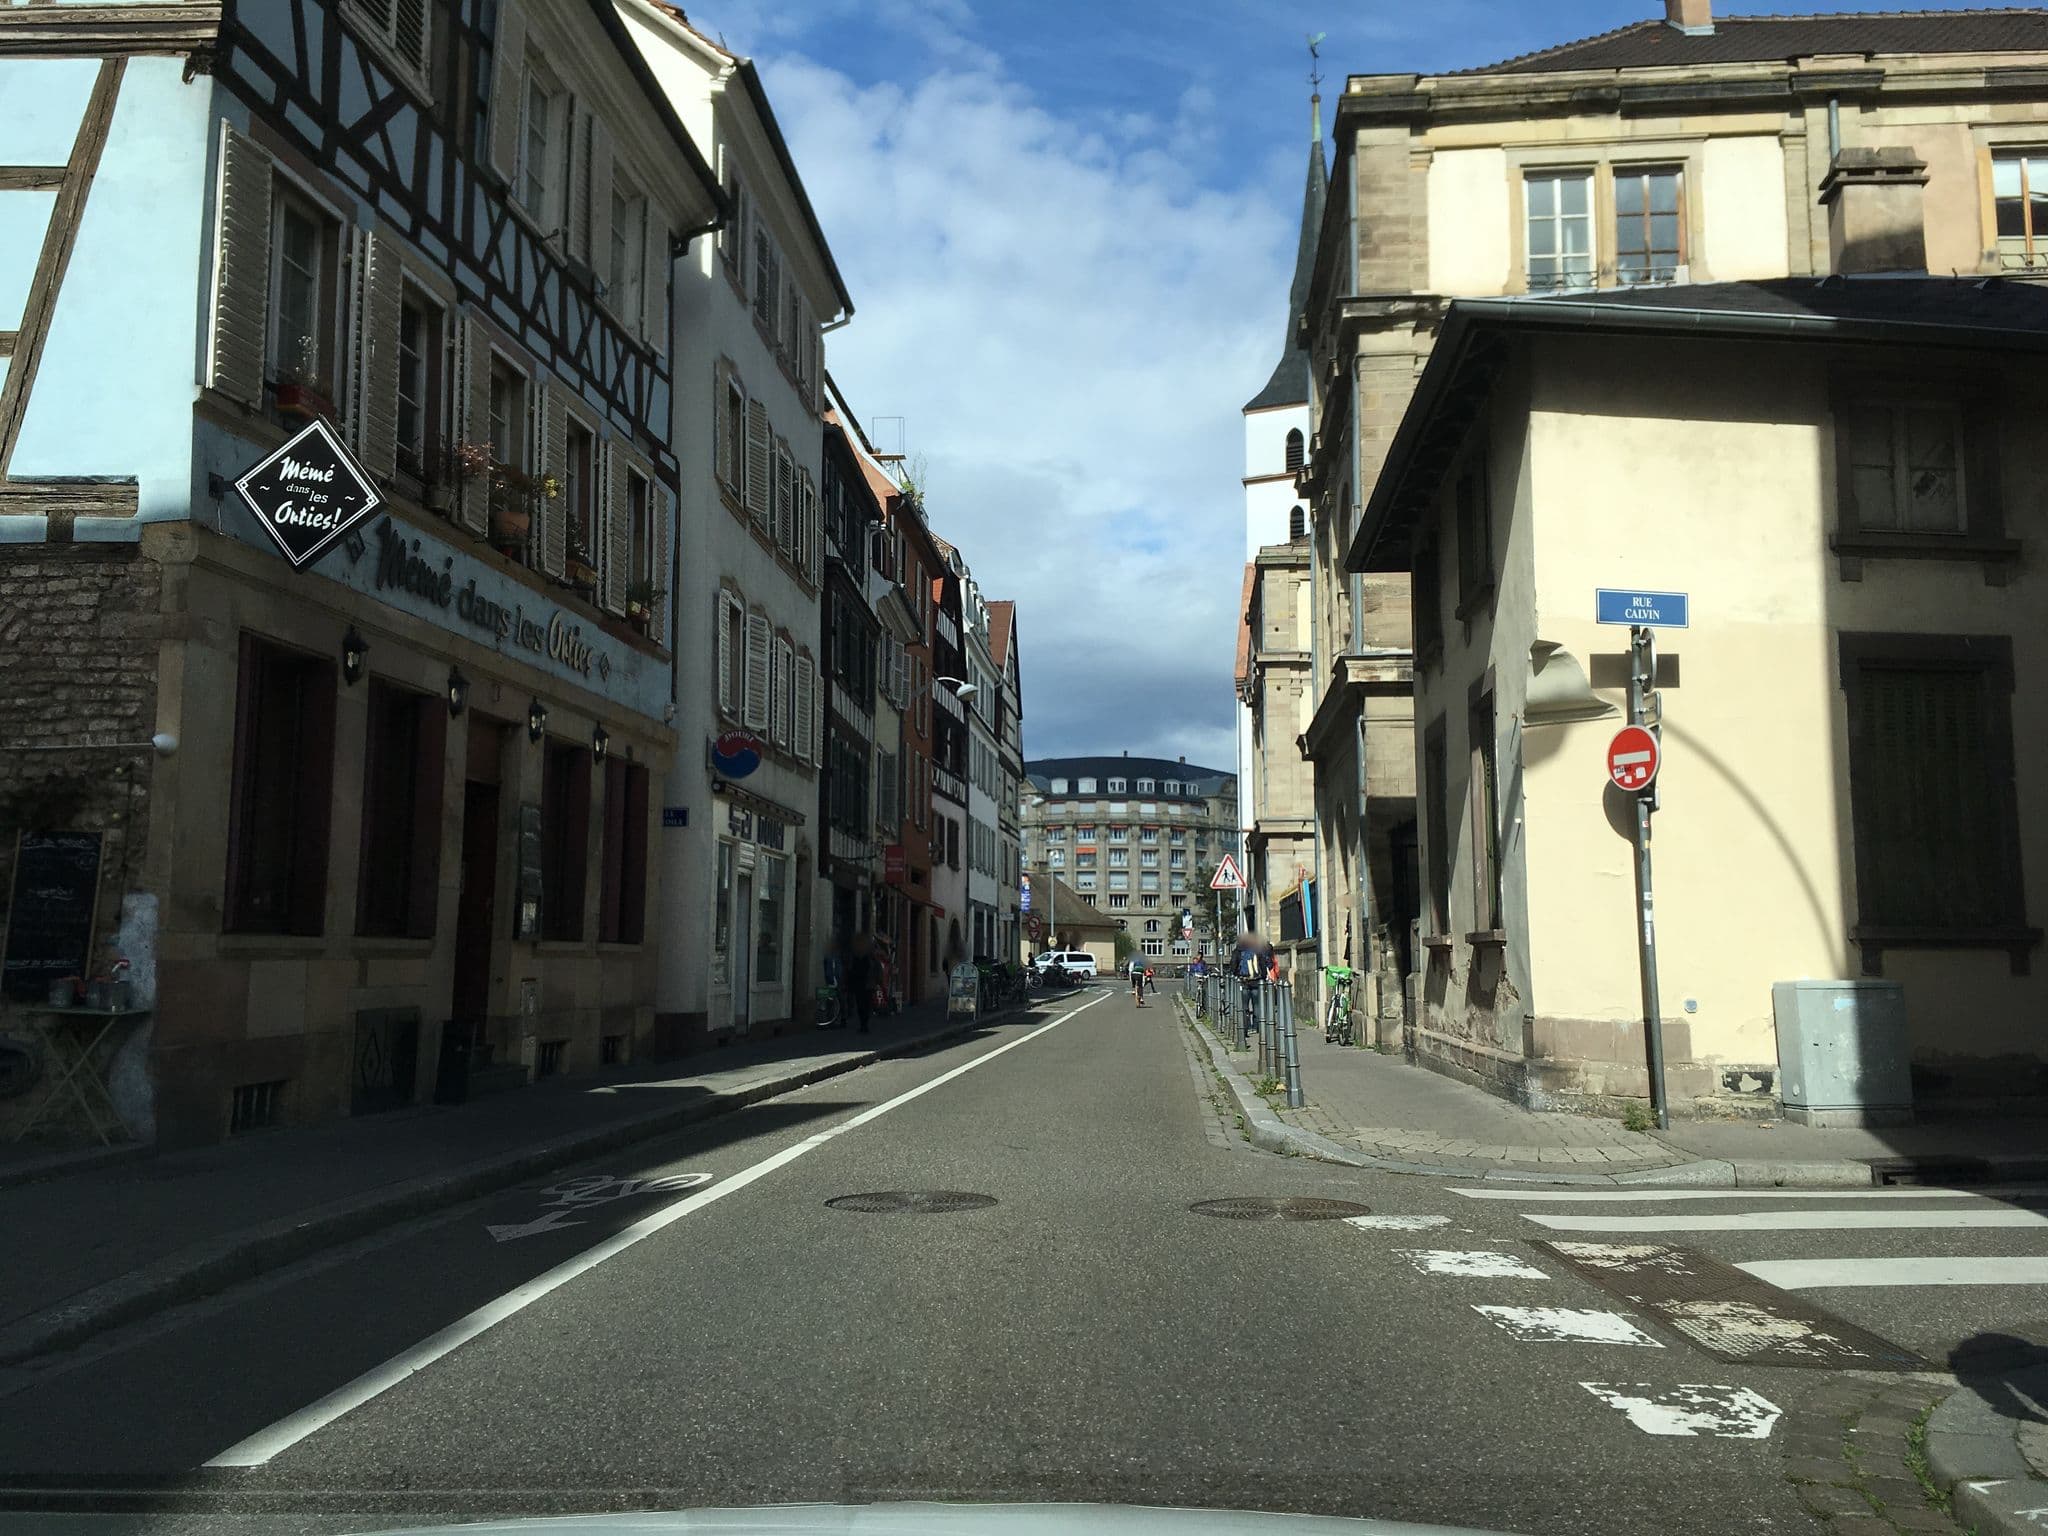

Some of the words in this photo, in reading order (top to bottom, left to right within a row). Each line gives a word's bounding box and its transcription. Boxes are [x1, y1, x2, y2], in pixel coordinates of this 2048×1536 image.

[279, 456, 335, 483] Mémé
[286, 483, 311, 494] dans
[308, 490, 329, 503] les
[275, 500, 342, 530] Orties!
[376, 515, 453, 608] Mémé
[459, 579, 512, 636] dans
[514, 603, 545, 652] les
[547, 609, 594, 678] Orties
[1632, 597, 1653, 607] RUE
[1625, 608, 1660, 620] CALVIN
